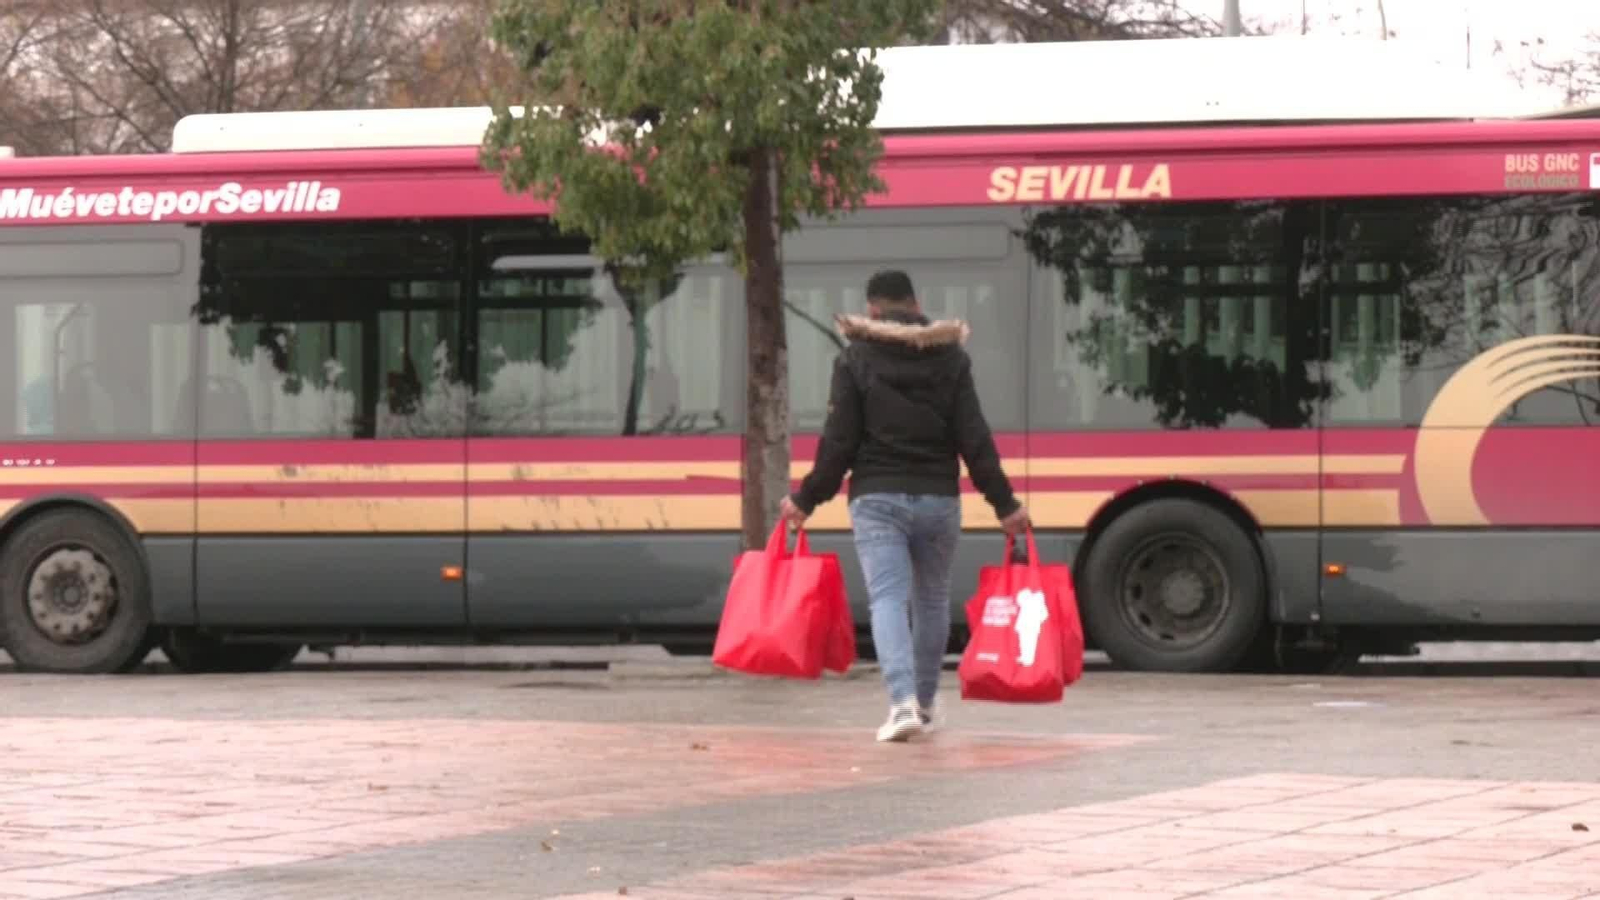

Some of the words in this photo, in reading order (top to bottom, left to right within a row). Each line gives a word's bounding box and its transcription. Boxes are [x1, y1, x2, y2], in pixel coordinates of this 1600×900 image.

[1505, 153, 1539, 172] BUS
[1544, 153, 1579, 172] GNC
[986, 163, 1172, 201] SEVILLA
